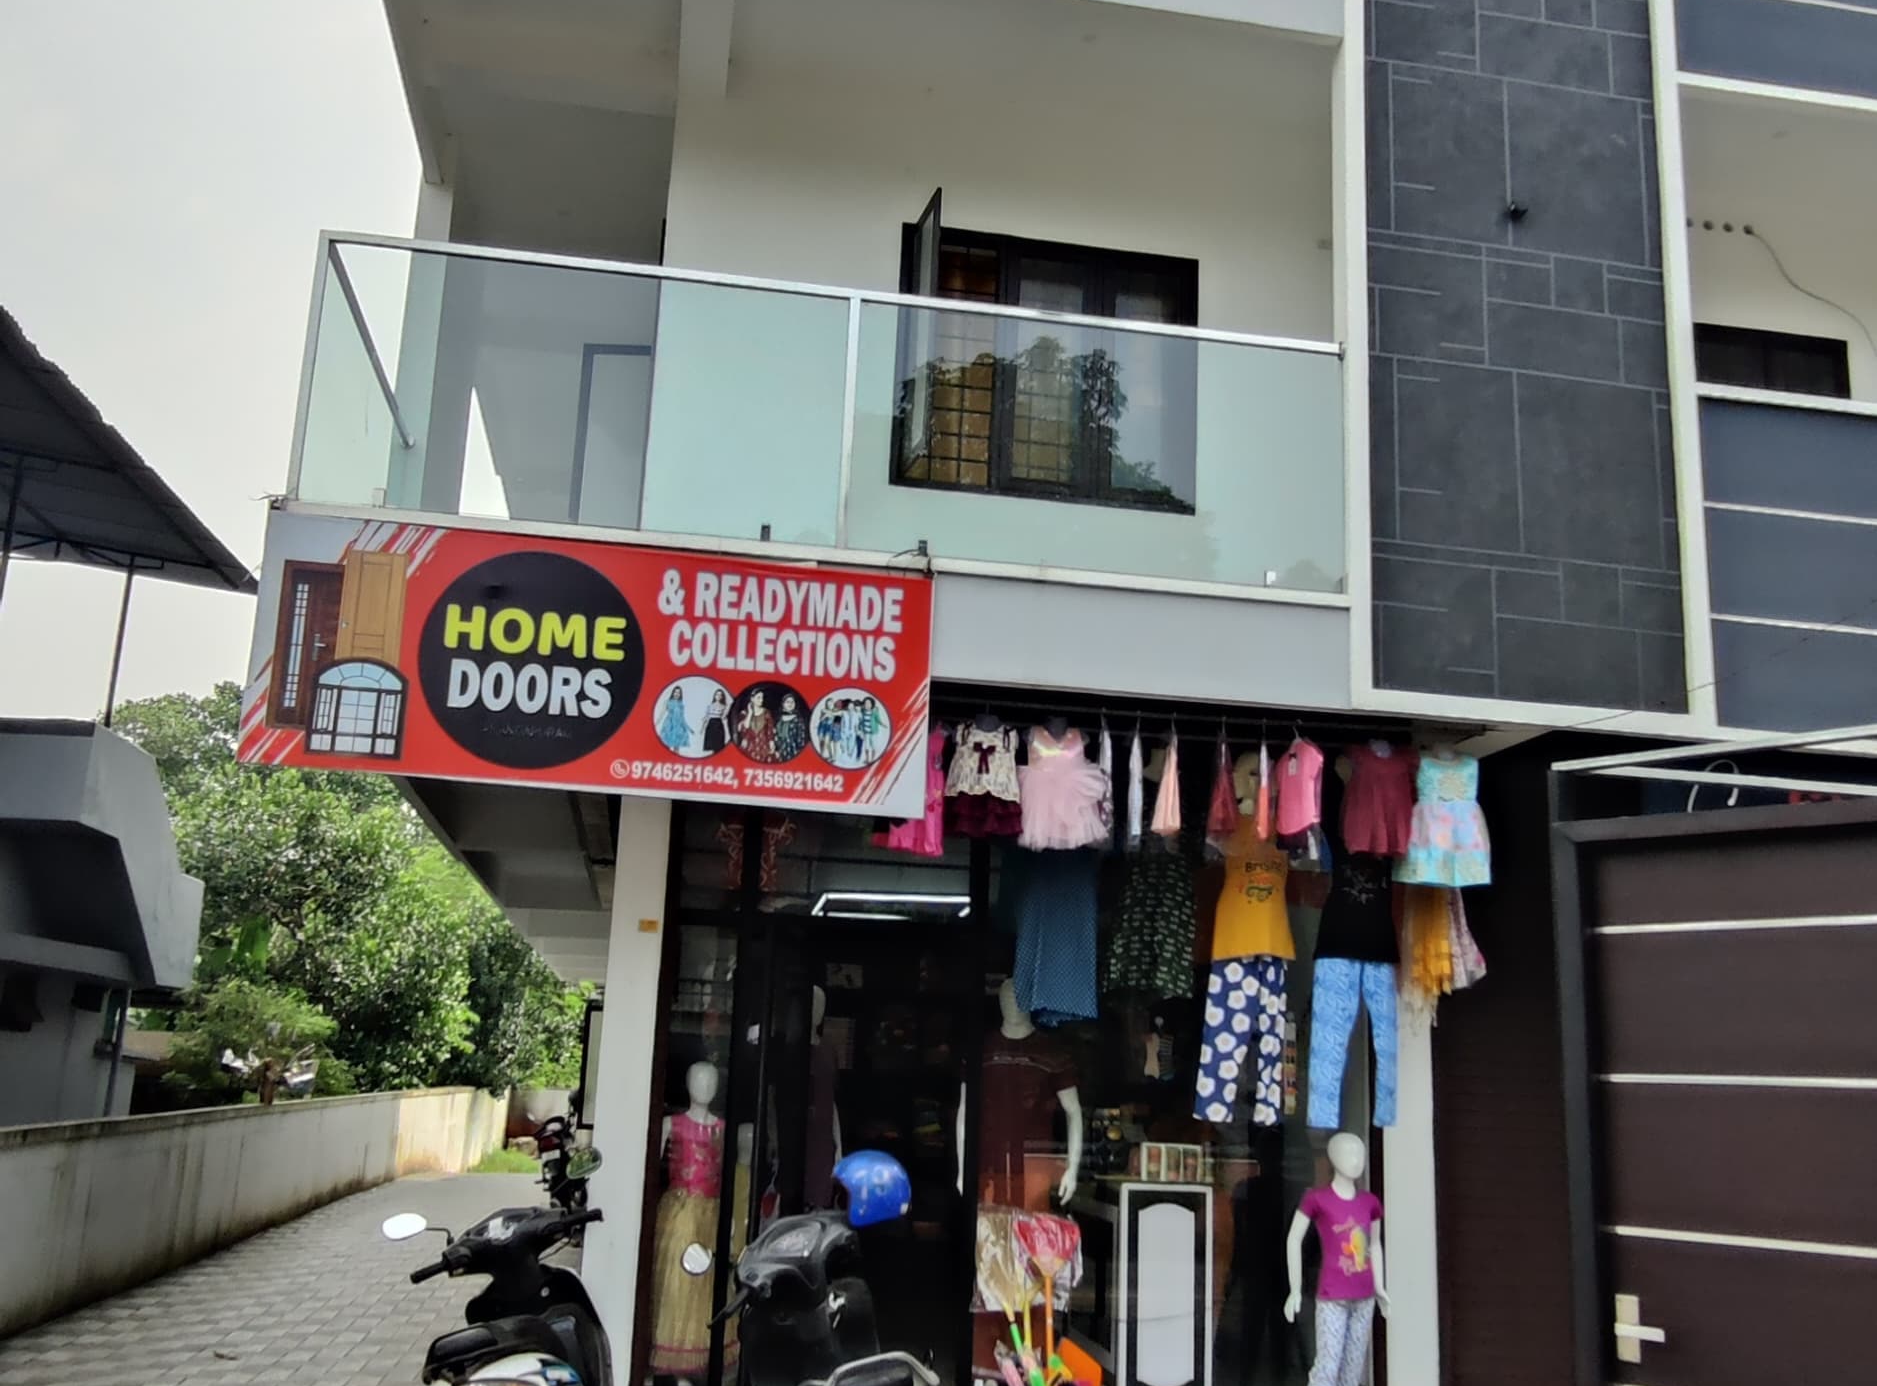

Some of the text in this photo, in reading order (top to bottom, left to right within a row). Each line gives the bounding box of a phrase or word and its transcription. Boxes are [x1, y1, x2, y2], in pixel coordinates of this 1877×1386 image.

[657, 568, 904, 633] & READYMADE
[443, 603, 628, 661] HOME
[669, 620, 896, 682] COLLECTIONS
[446, 657, 613, 719] DOORS
[631, 760, 844, 793] 9746251642, 7356921642
